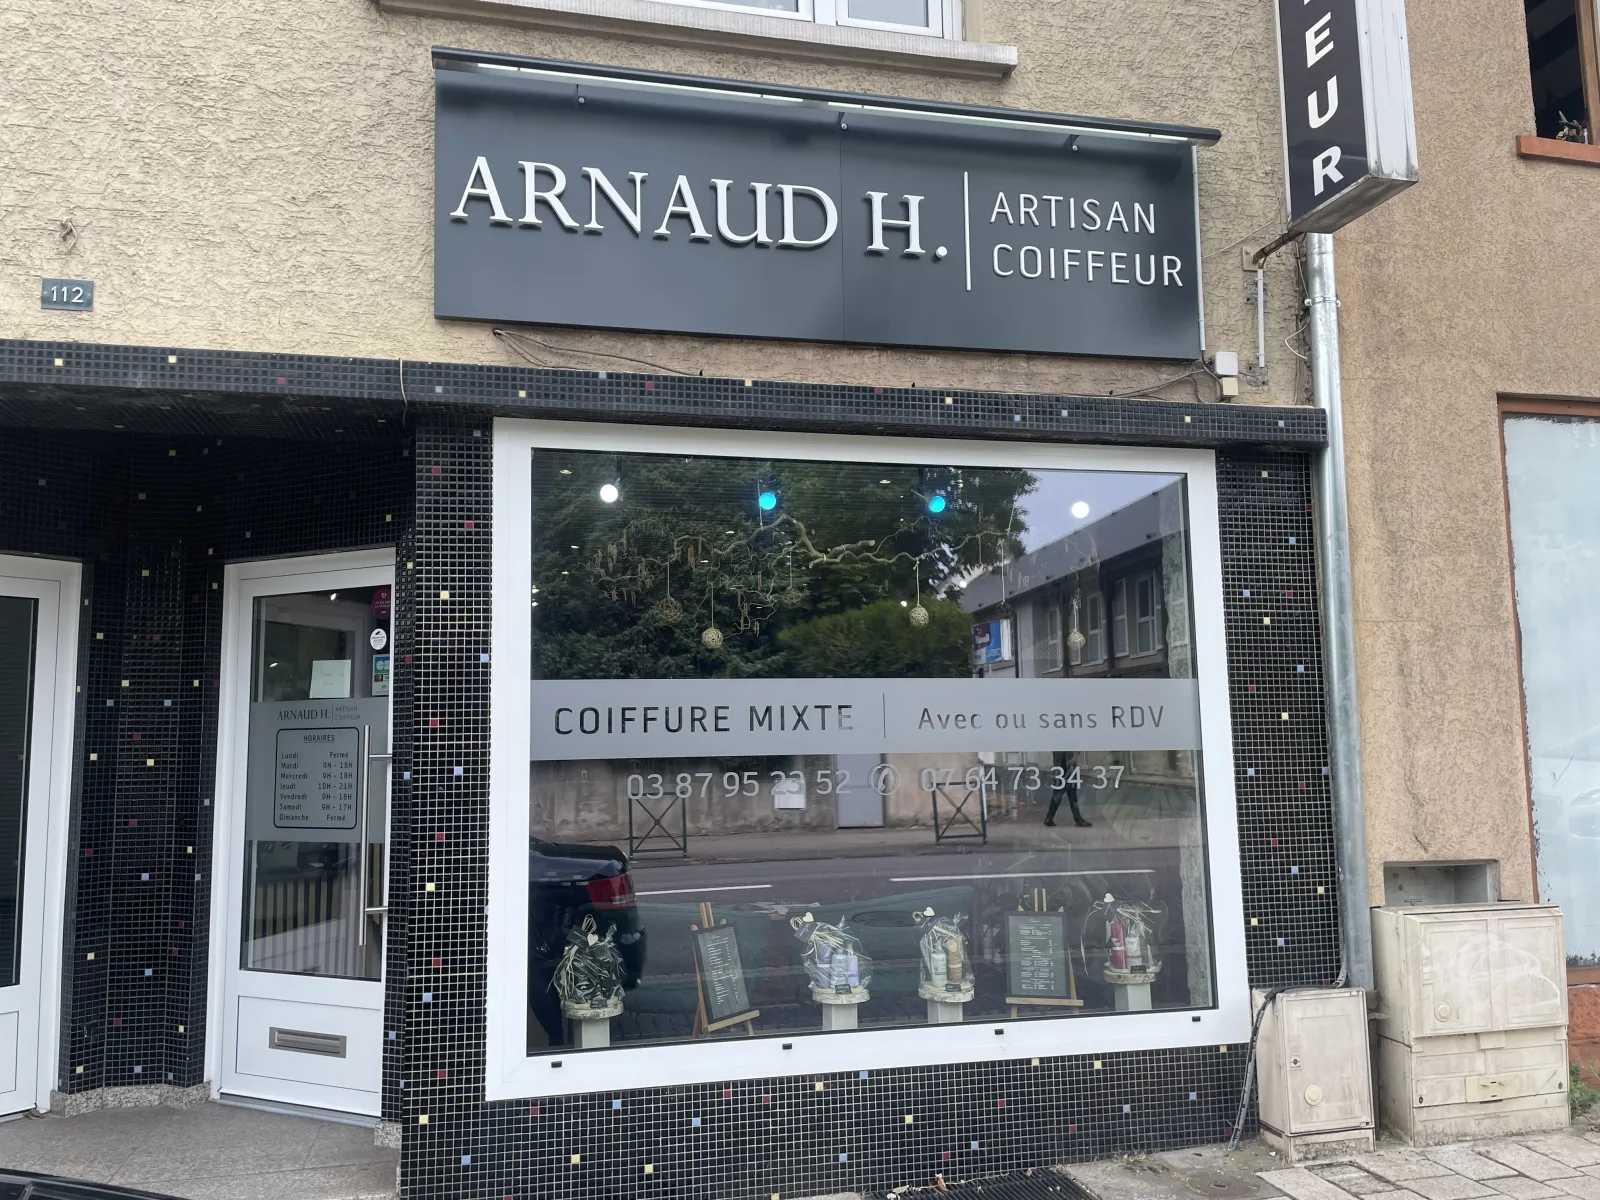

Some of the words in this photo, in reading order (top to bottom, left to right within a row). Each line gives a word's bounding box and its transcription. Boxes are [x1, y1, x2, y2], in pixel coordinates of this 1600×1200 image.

[1303, 0, 1345, 197] EUR
[449, 155, 839, 248] ARNAUD
[865, 190, 948, 257] H.
[989, 191, 1156, 235] ARTISAN
[992, 243, 1184, 287] COIFFEUR
[51, 285, 84, 303] 112
[276, 708, 319, 721] ARNAUD
[335, 705, 358, 713] ARTISAN
[554, 705, 731, 735] COIFFURE
[749, 704, 854, 732] MIXTE
[917, 707, 983, 730] Avec
[995, 713, 1027, 729] ou
[1038, 712, 1098, 729] sans
[1110, 705, 1165, 729] RDV
[303, 734, 336, 742] HORAIRES
[281, 751, 299, 759] Lundi
[329, 751, 349, 759] Fermé
[280, 761, 299, 769] Mardi
[322, 761, 332, 769] 9H
[340, 761, 353, 769] 18H
[280, 772, 308, 780] Mercredi
[279, 782, 296, 790] Jeudi
[318, 782, 331, 790] 10H
[338, 782, 353, 790] 21H
[627, 773, 664, 800] 03
[675, 772, 714, 798] 87
[722, 771, 760, 798] 95
[815, 769, 851, 795] 52
[920, 767, 953, 792] 07
[965, 766, 998, 791] 64
[1007, 766, 1041, 791] 73
[1050, 766, 1083, 790] 34
[1091, 765, 1125, 789] 37
[279, 793, 308, 801] Vendredi
[321, 793, 331, 801] 9H
[279, 803, 302, 811] Samedi
[321, 803, 331, 811] 9H
[338, 803, 352, 811] 17H
[279, 813, 309, 821] Dimanche
[326, 813, 346, 822] Fermé
